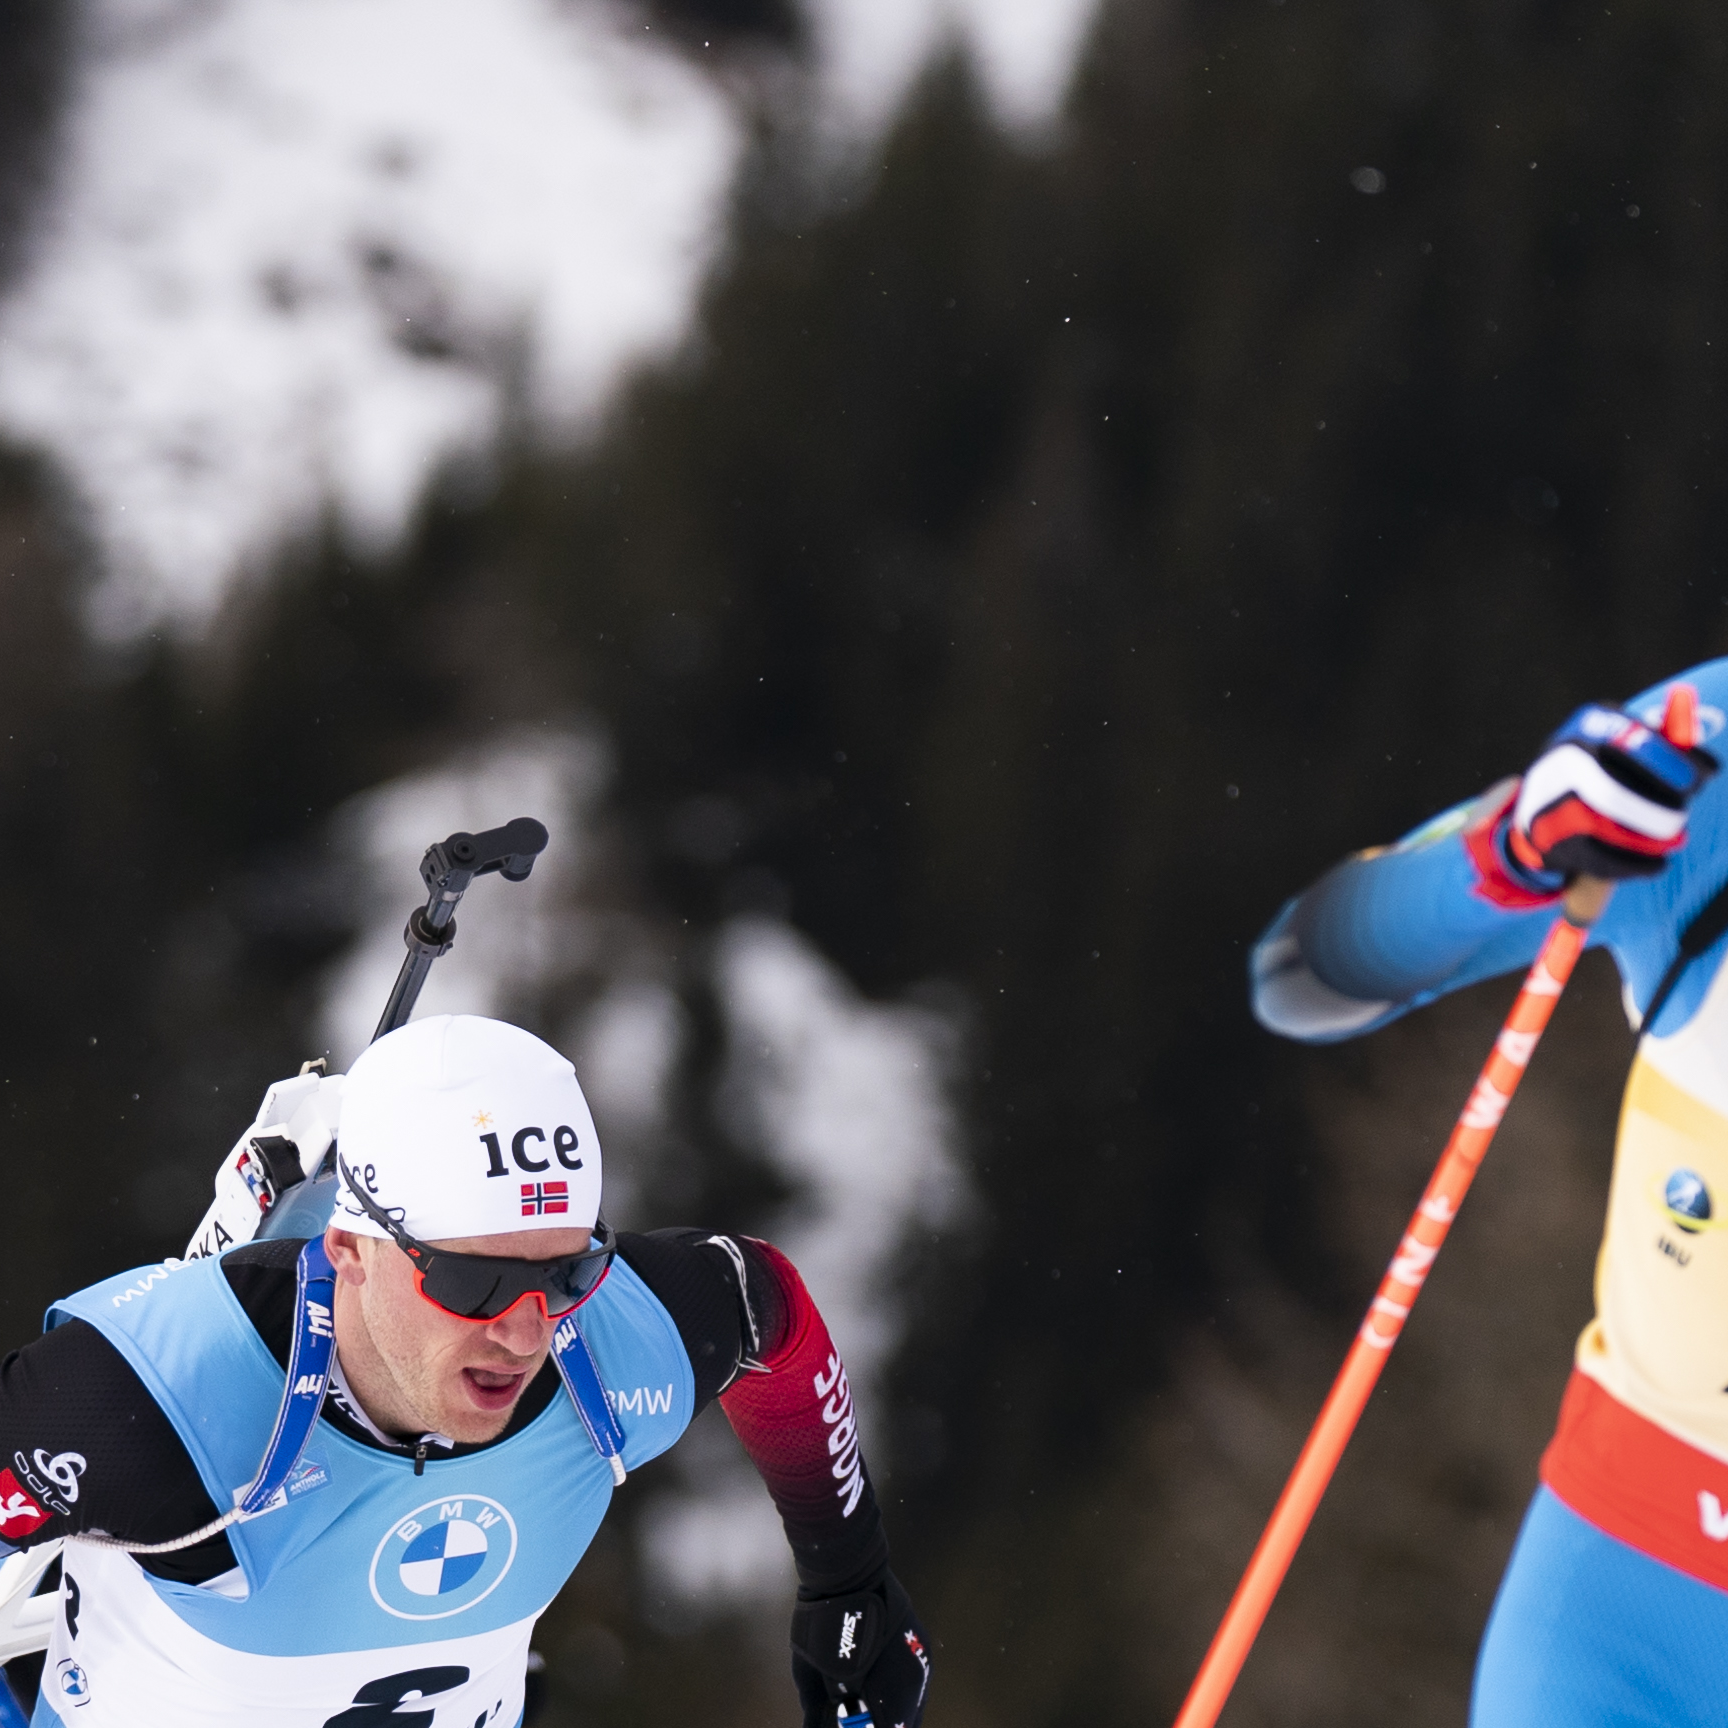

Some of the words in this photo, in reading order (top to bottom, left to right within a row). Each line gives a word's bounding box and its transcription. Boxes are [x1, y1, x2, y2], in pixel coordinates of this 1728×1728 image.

[814, 1352, 865, 1519] NORGE
[14, 1450, 71, 1516] odlo
[396, 1501, 502, 1543] BMW
